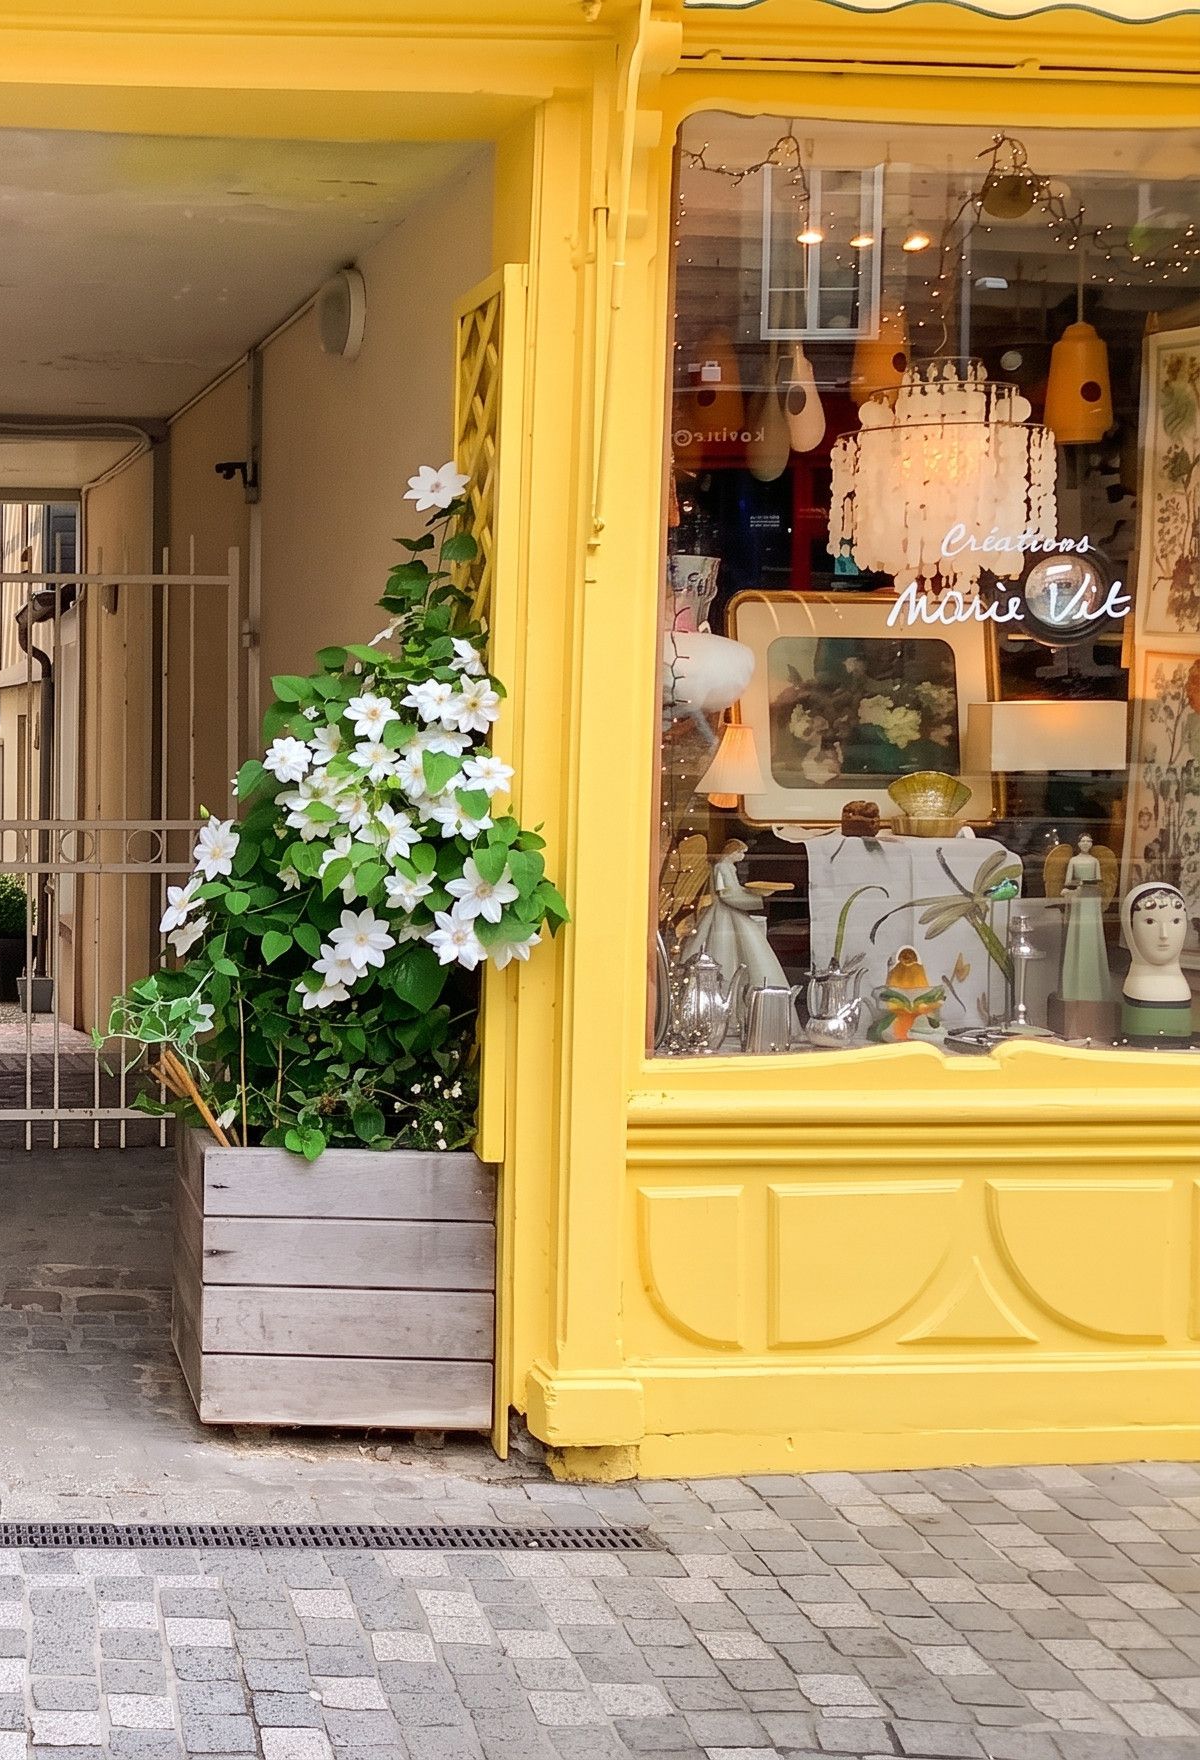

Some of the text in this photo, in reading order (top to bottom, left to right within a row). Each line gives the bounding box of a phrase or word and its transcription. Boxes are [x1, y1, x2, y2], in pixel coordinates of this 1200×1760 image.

[941, 523, 1096, 558] Créations
[886, 564, 1132, 628] Marie Vit
